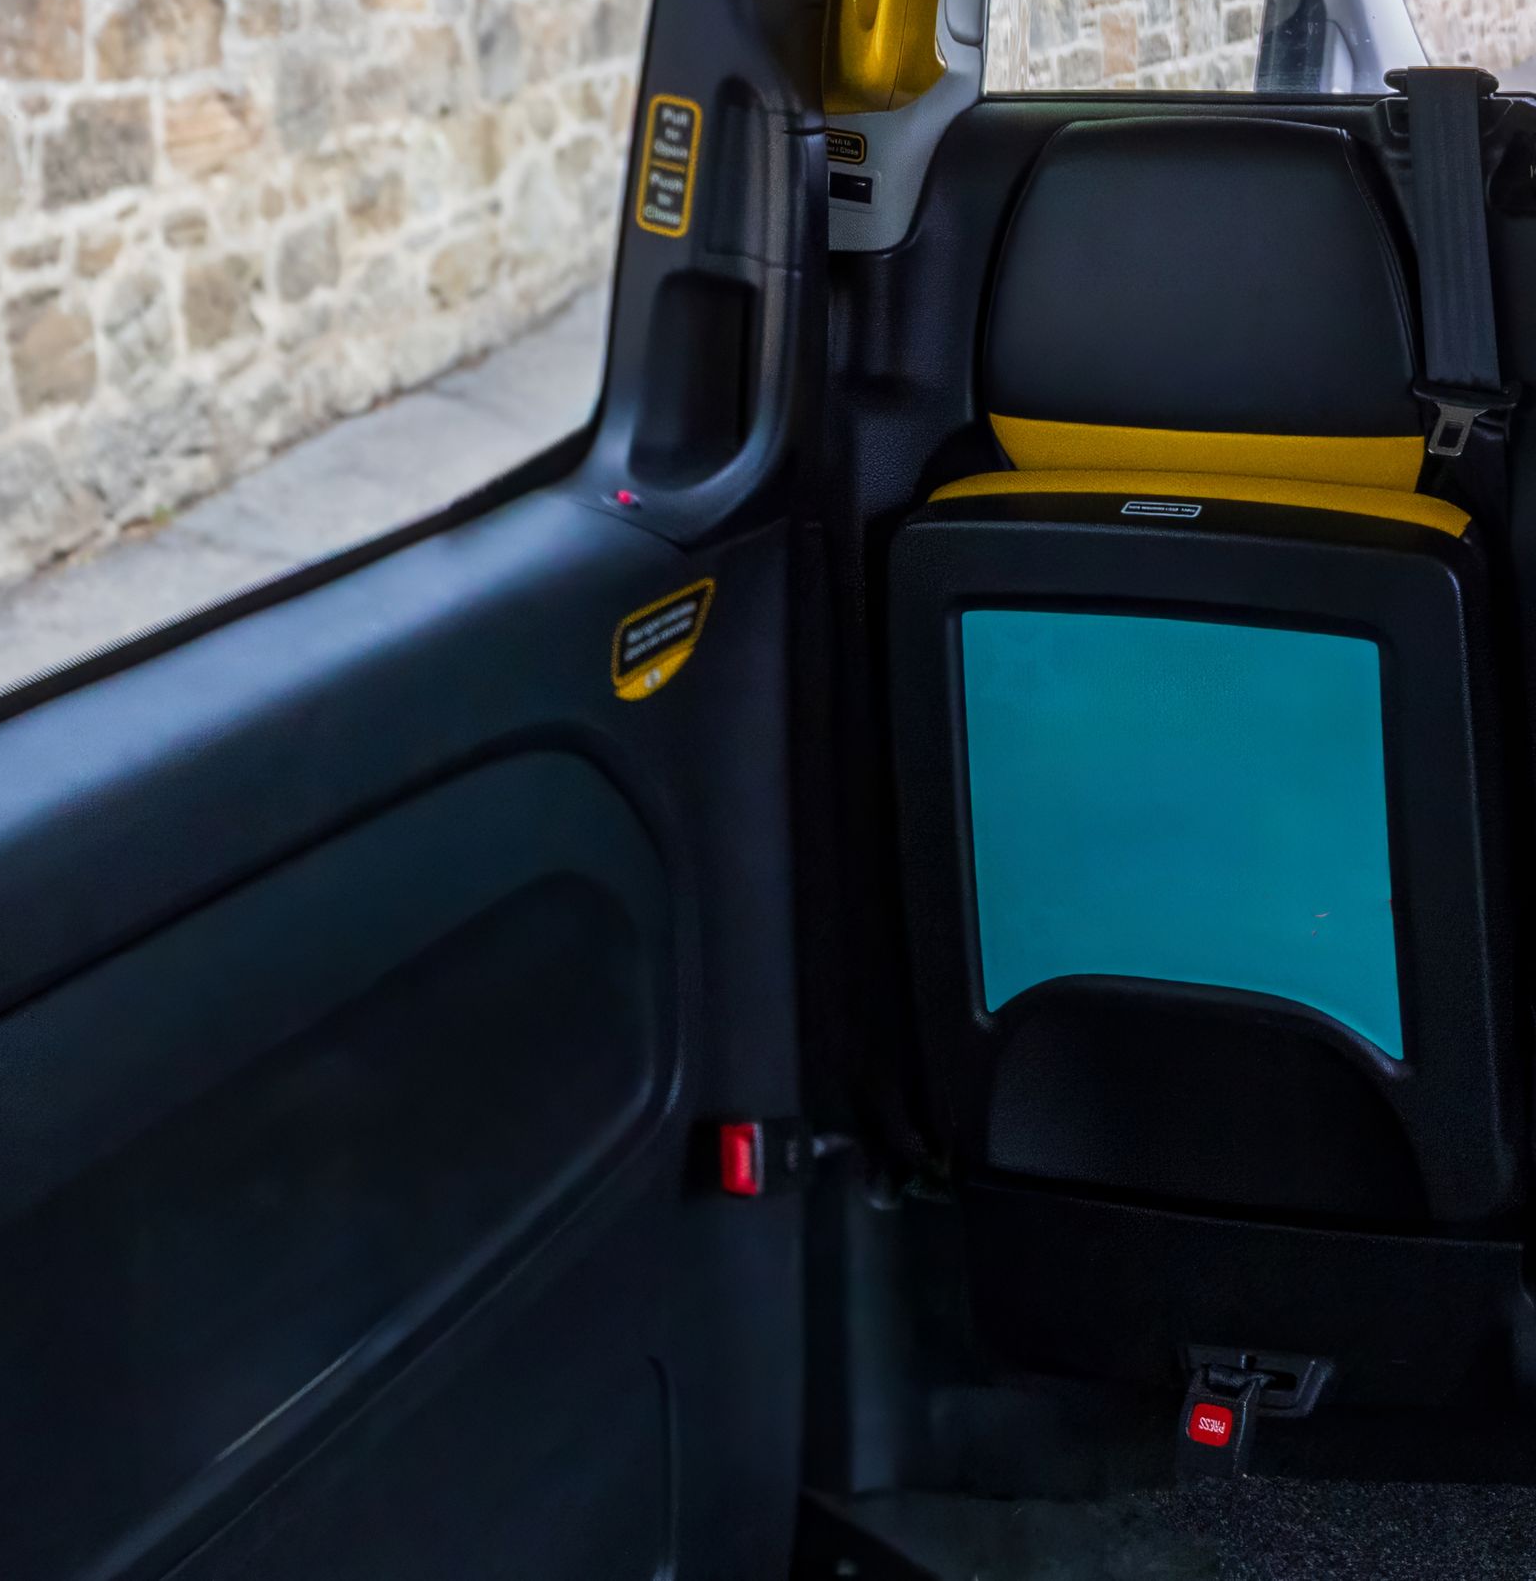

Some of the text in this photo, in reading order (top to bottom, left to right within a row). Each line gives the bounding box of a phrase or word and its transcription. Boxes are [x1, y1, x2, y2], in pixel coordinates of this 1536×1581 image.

[662, 107, 689, 127] Pull
[654, 139, 689, 158] Open
[650, 172, 684, 191] Push
[644, 206, 681, 225] Close
[1198, 1416, 1226, 1434] PRESS
